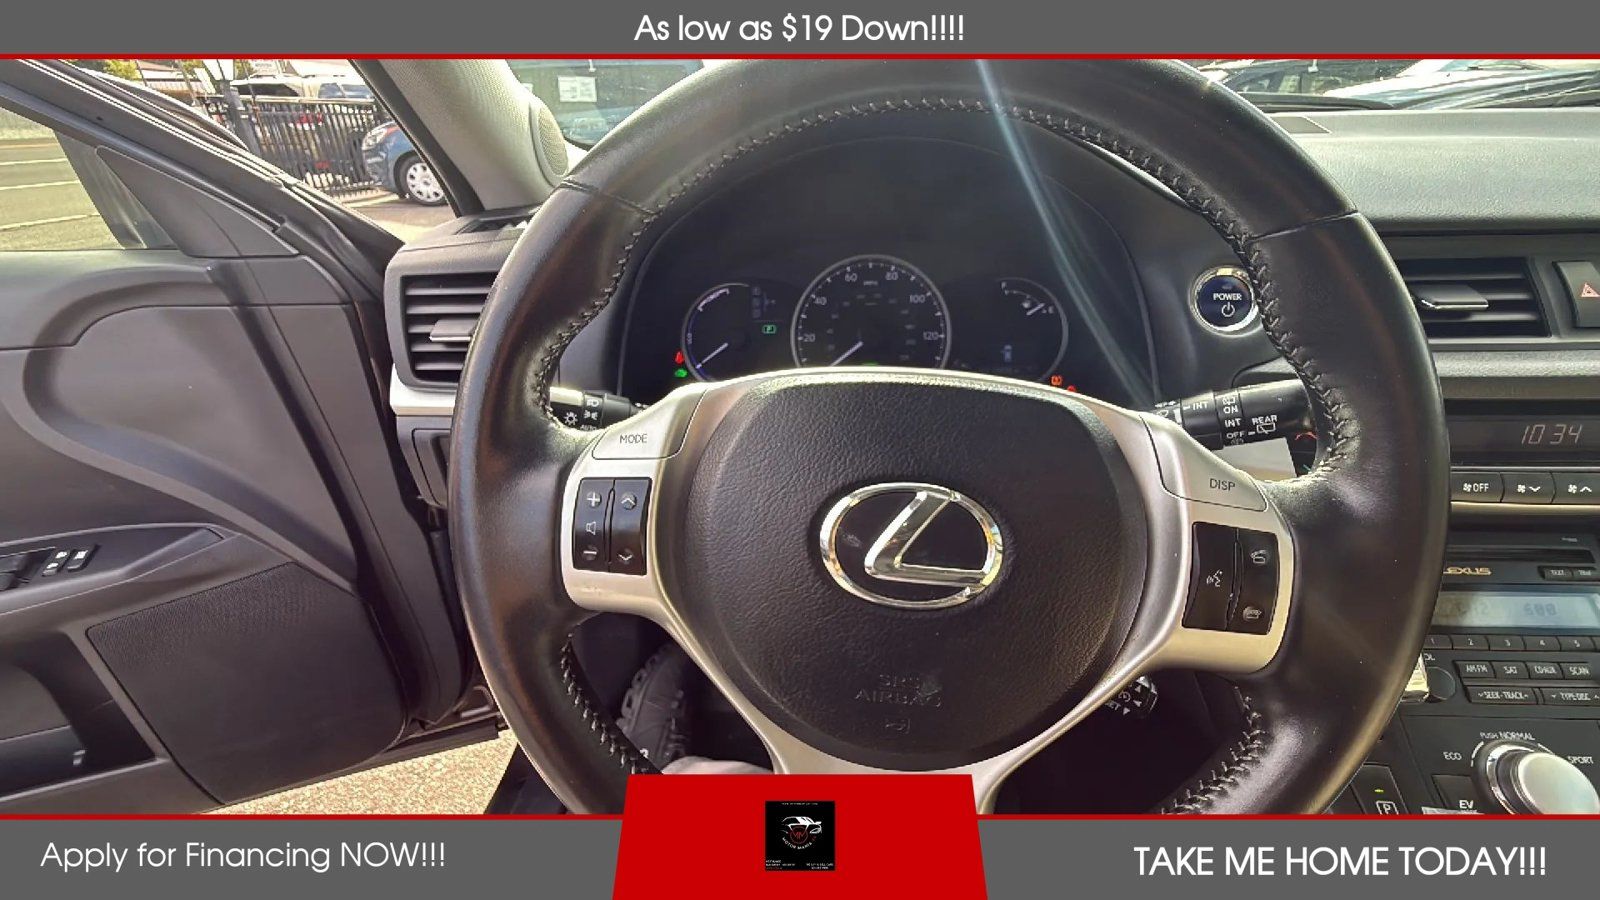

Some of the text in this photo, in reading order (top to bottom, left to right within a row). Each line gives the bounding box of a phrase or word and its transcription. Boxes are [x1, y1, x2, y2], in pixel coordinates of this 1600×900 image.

[844, 273, 858, 283] 60
[814, 296, 828, 306] 40
[909, 294, 926, 304] 100
[1213, 292, 1243, 301] POWER
[803, 333, 816, 343] 20
[922, 331, 939, 341] 120
[1192, 401, 1209, 411] INT
[1223, 404, 1239, 414] ON
[1224, 417, 1242, 428] INT
[1251, 414, 1278, 426] REAR
[619, 433, 648, 444] MODE
[1226, 431, 1245, 440] OFF
[1209, 477, 1236, 492] DISP
[1472, 482, 1490, 493] OFF
[1568, 666, 1590, 677] SCAN
[1499, 731, 1536, 741] NORMAL
[1442, 751, 1463, 761] ECO
[1567, 755, 1594, 764] SPORT
[1459, 799, 1474, 809] EV
